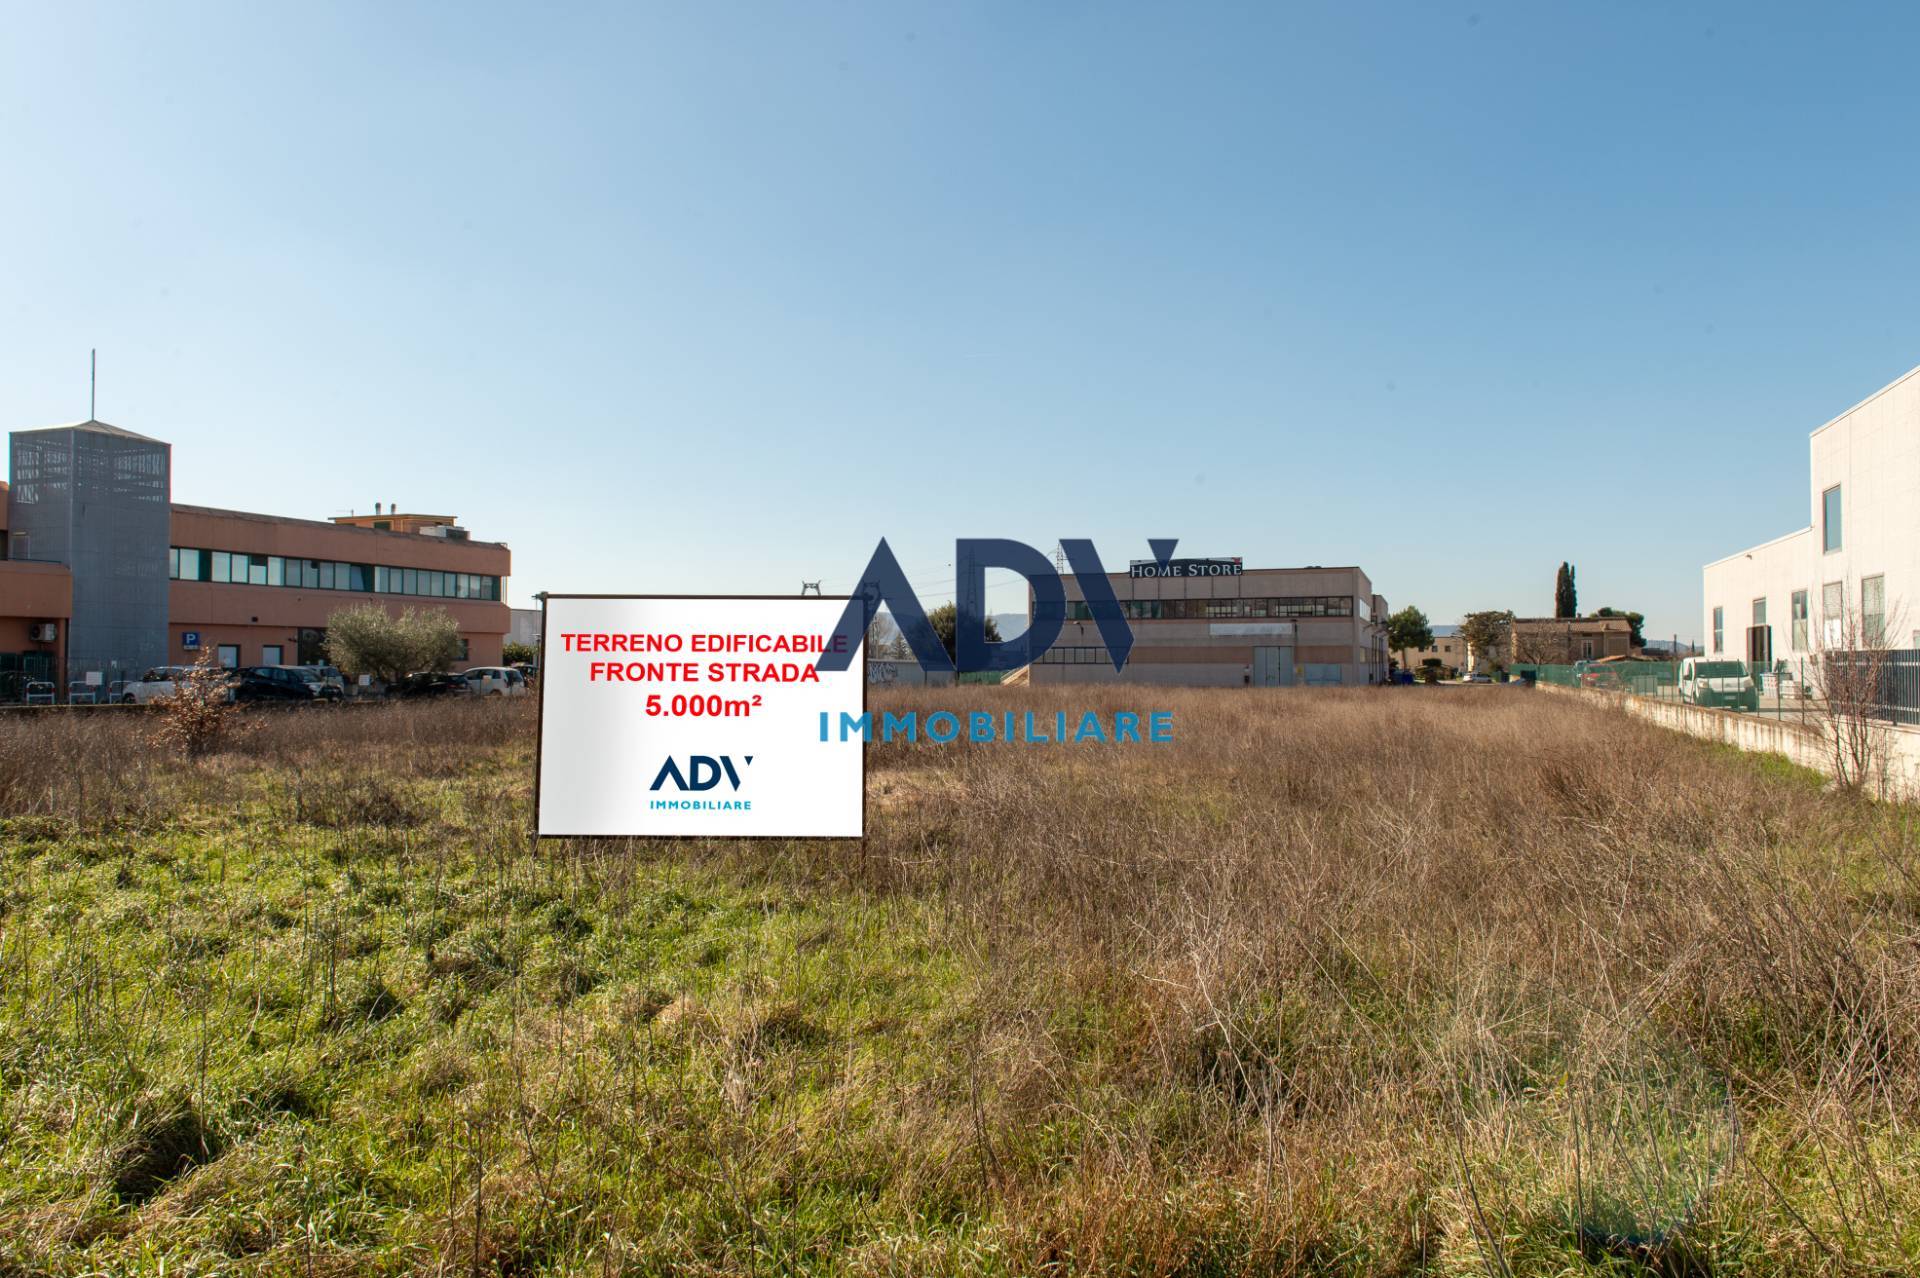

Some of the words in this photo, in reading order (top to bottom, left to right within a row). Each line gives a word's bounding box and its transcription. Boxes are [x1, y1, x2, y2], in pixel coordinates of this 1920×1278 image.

[1131, 565, 1182, 577] HOME
[1188, 563, 1242, 577] STORE
[560, 633, 683, 652] TERRENO
[691, 634, 848, 653] EDIFICABILE
[590, 662, 699, 682] FRONTE
[707, 662, 820, 683] STRADA
[649, 755, 753, 792] ADV
[650, 800, 752, 810] IMMOBILIARE
